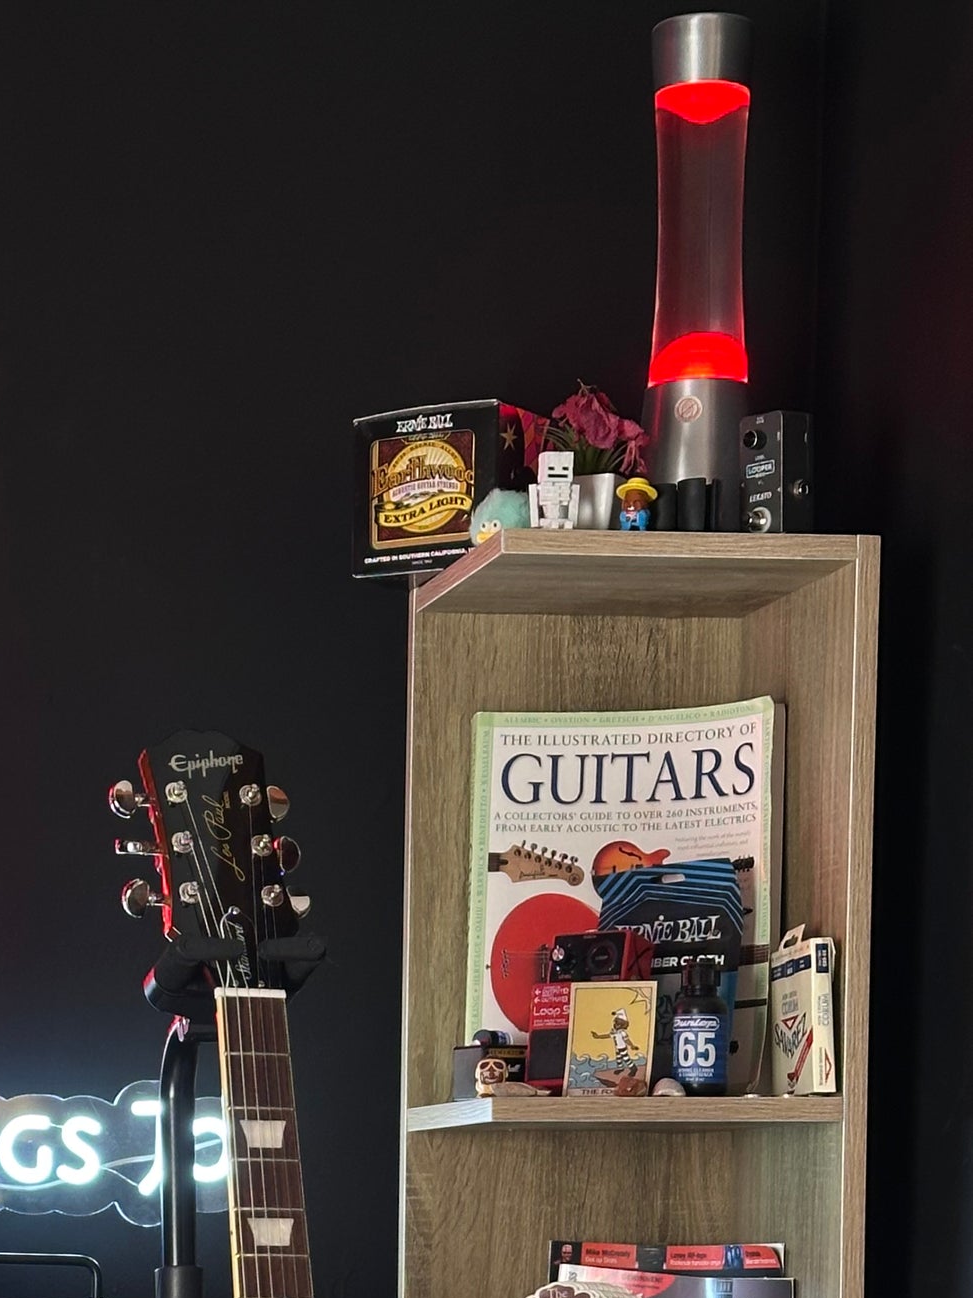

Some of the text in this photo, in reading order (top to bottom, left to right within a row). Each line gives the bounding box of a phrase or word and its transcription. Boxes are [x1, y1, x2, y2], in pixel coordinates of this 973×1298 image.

[748, 463, 772, 475] LOOPER
[383, 496, 467, 524] EXTRA LIGHT
[500, 722, 757, 746] THE ILLUSTRATED DIRECTORY OF
[168, 750, 244, 779] Epiphone
[500, 741, 756, 806] GUITARS
[494, 811, 501, 820] A
[579, 811, 613, 820] GUIDE
[617, 810, 631, 820] TO
[633, 810, 663, 819] OVER
[666, 808, 683, 818] 260
[495, 813, 757, 833] FROM EARLY ACOUSTIC TO THE LATEST ELECTRICS
[201, 795, 245, 881] Les Paul
[673, 914, 721, 943] BALL
[533, 1006, 561, 1018] Loop
[673, 1018, 717, 1029] Dunlop
[678, 1031, 716, 1067] 65
